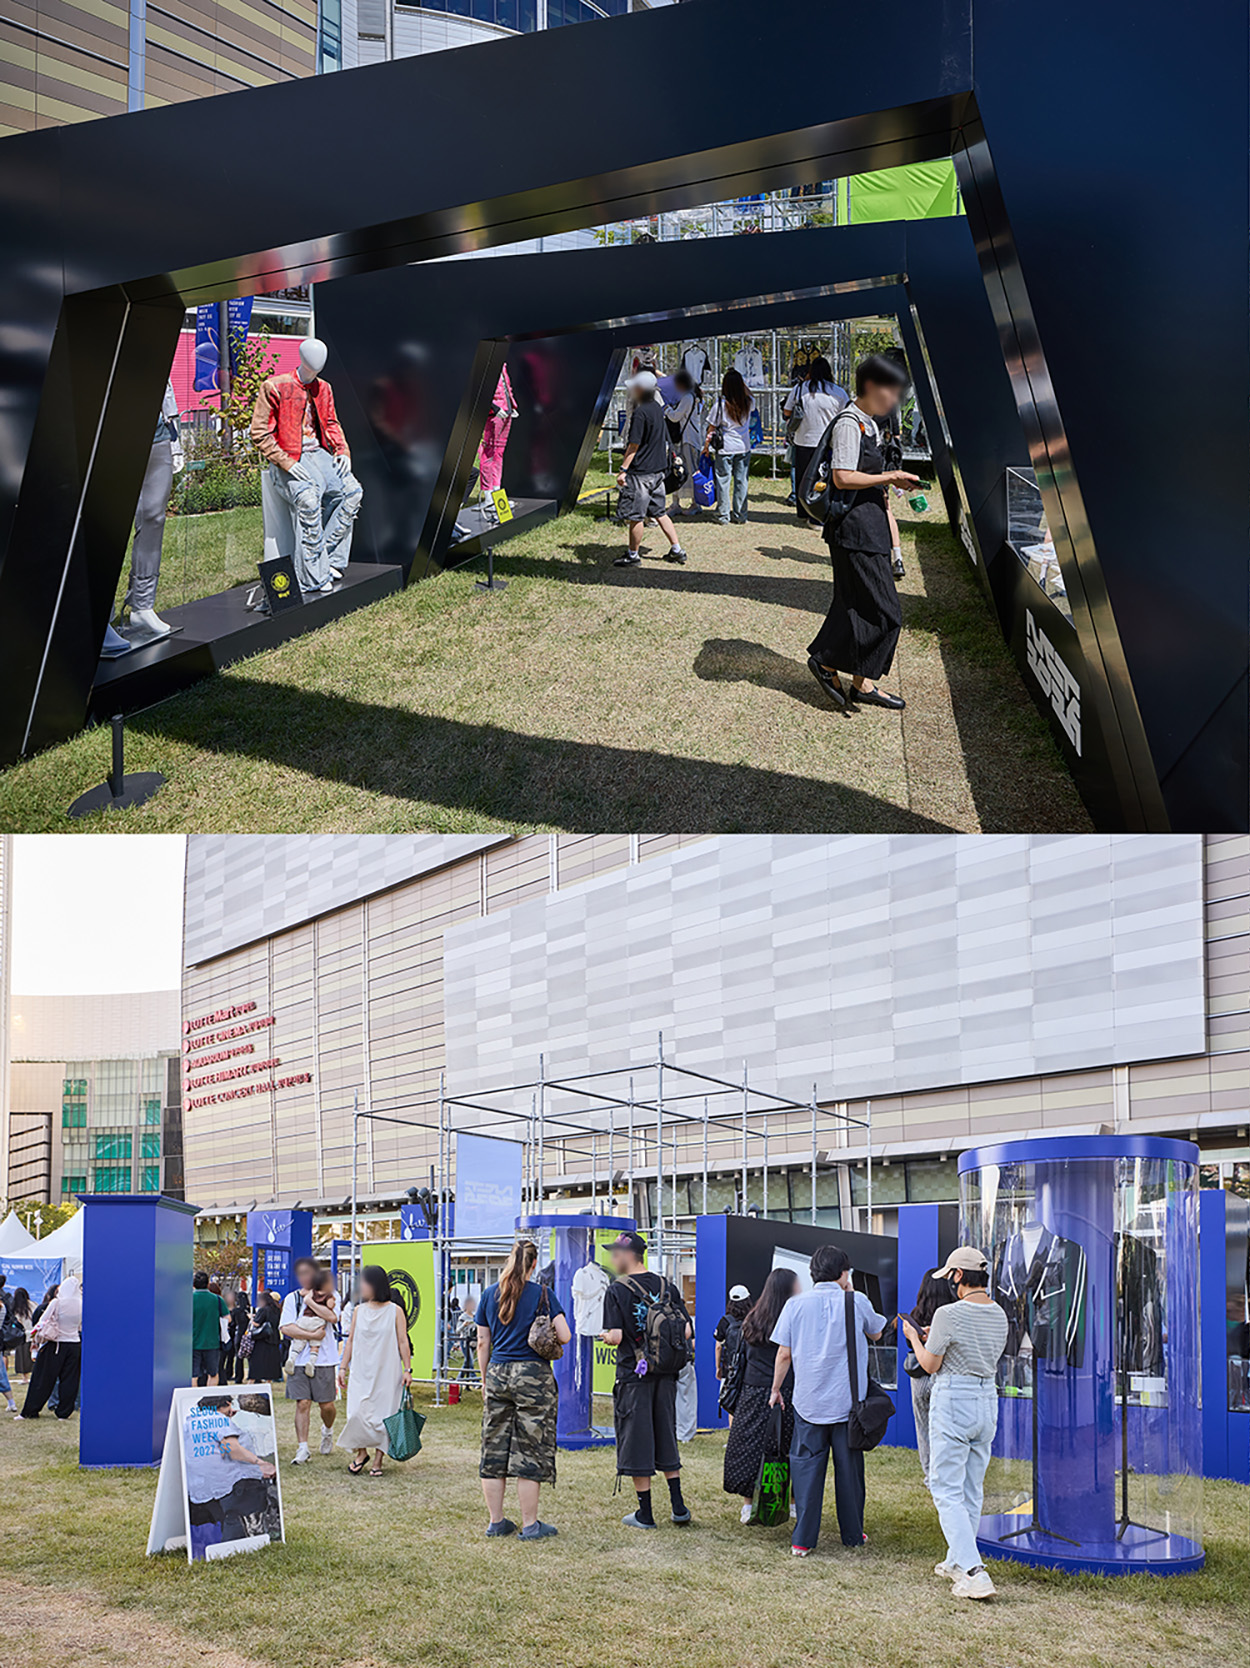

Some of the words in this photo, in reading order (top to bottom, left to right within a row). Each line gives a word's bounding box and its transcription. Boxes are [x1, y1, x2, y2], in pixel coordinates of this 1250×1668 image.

[596, 1347, 618, 1366] WIS
[190, 1405, 220, 1418] SEOUL
[191, 1417, 230, 1431] FASHION
[191, 1431, 220, 1444] WEEK
[193, 1445, 216, 1458] 2027
[219, 1442, 232, 1455] SS
